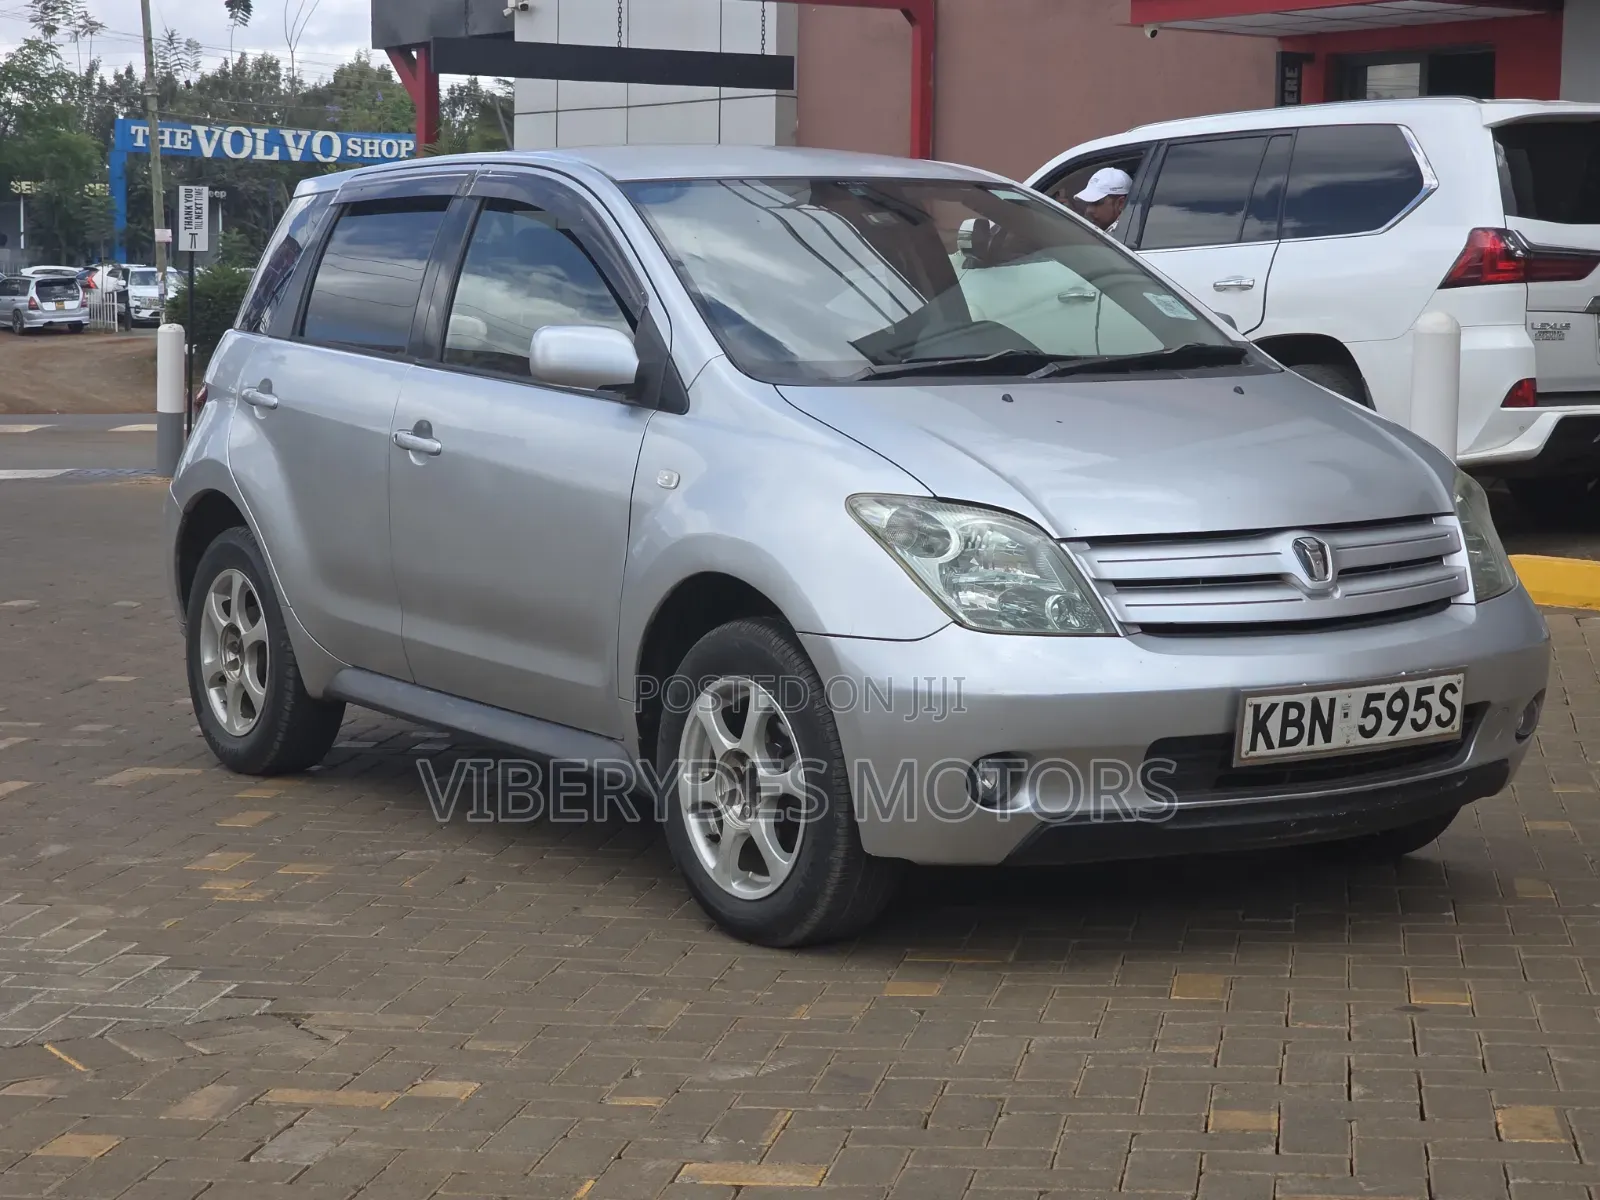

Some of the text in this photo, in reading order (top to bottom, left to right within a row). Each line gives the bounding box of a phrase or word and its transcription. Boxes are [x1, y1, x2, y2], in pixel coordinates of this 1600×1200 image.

[1284, 66, 1298, 103] ERE
[131, 125, 415, 162] THE VOLVO SHOP
[184, 188, 193, 230] THANK YOU
[194, 188, 203, 230] TILL NEXT TIME
[208, 190, 227, 199] eep
[1249, 682, 1459, 752] KBN 595S
